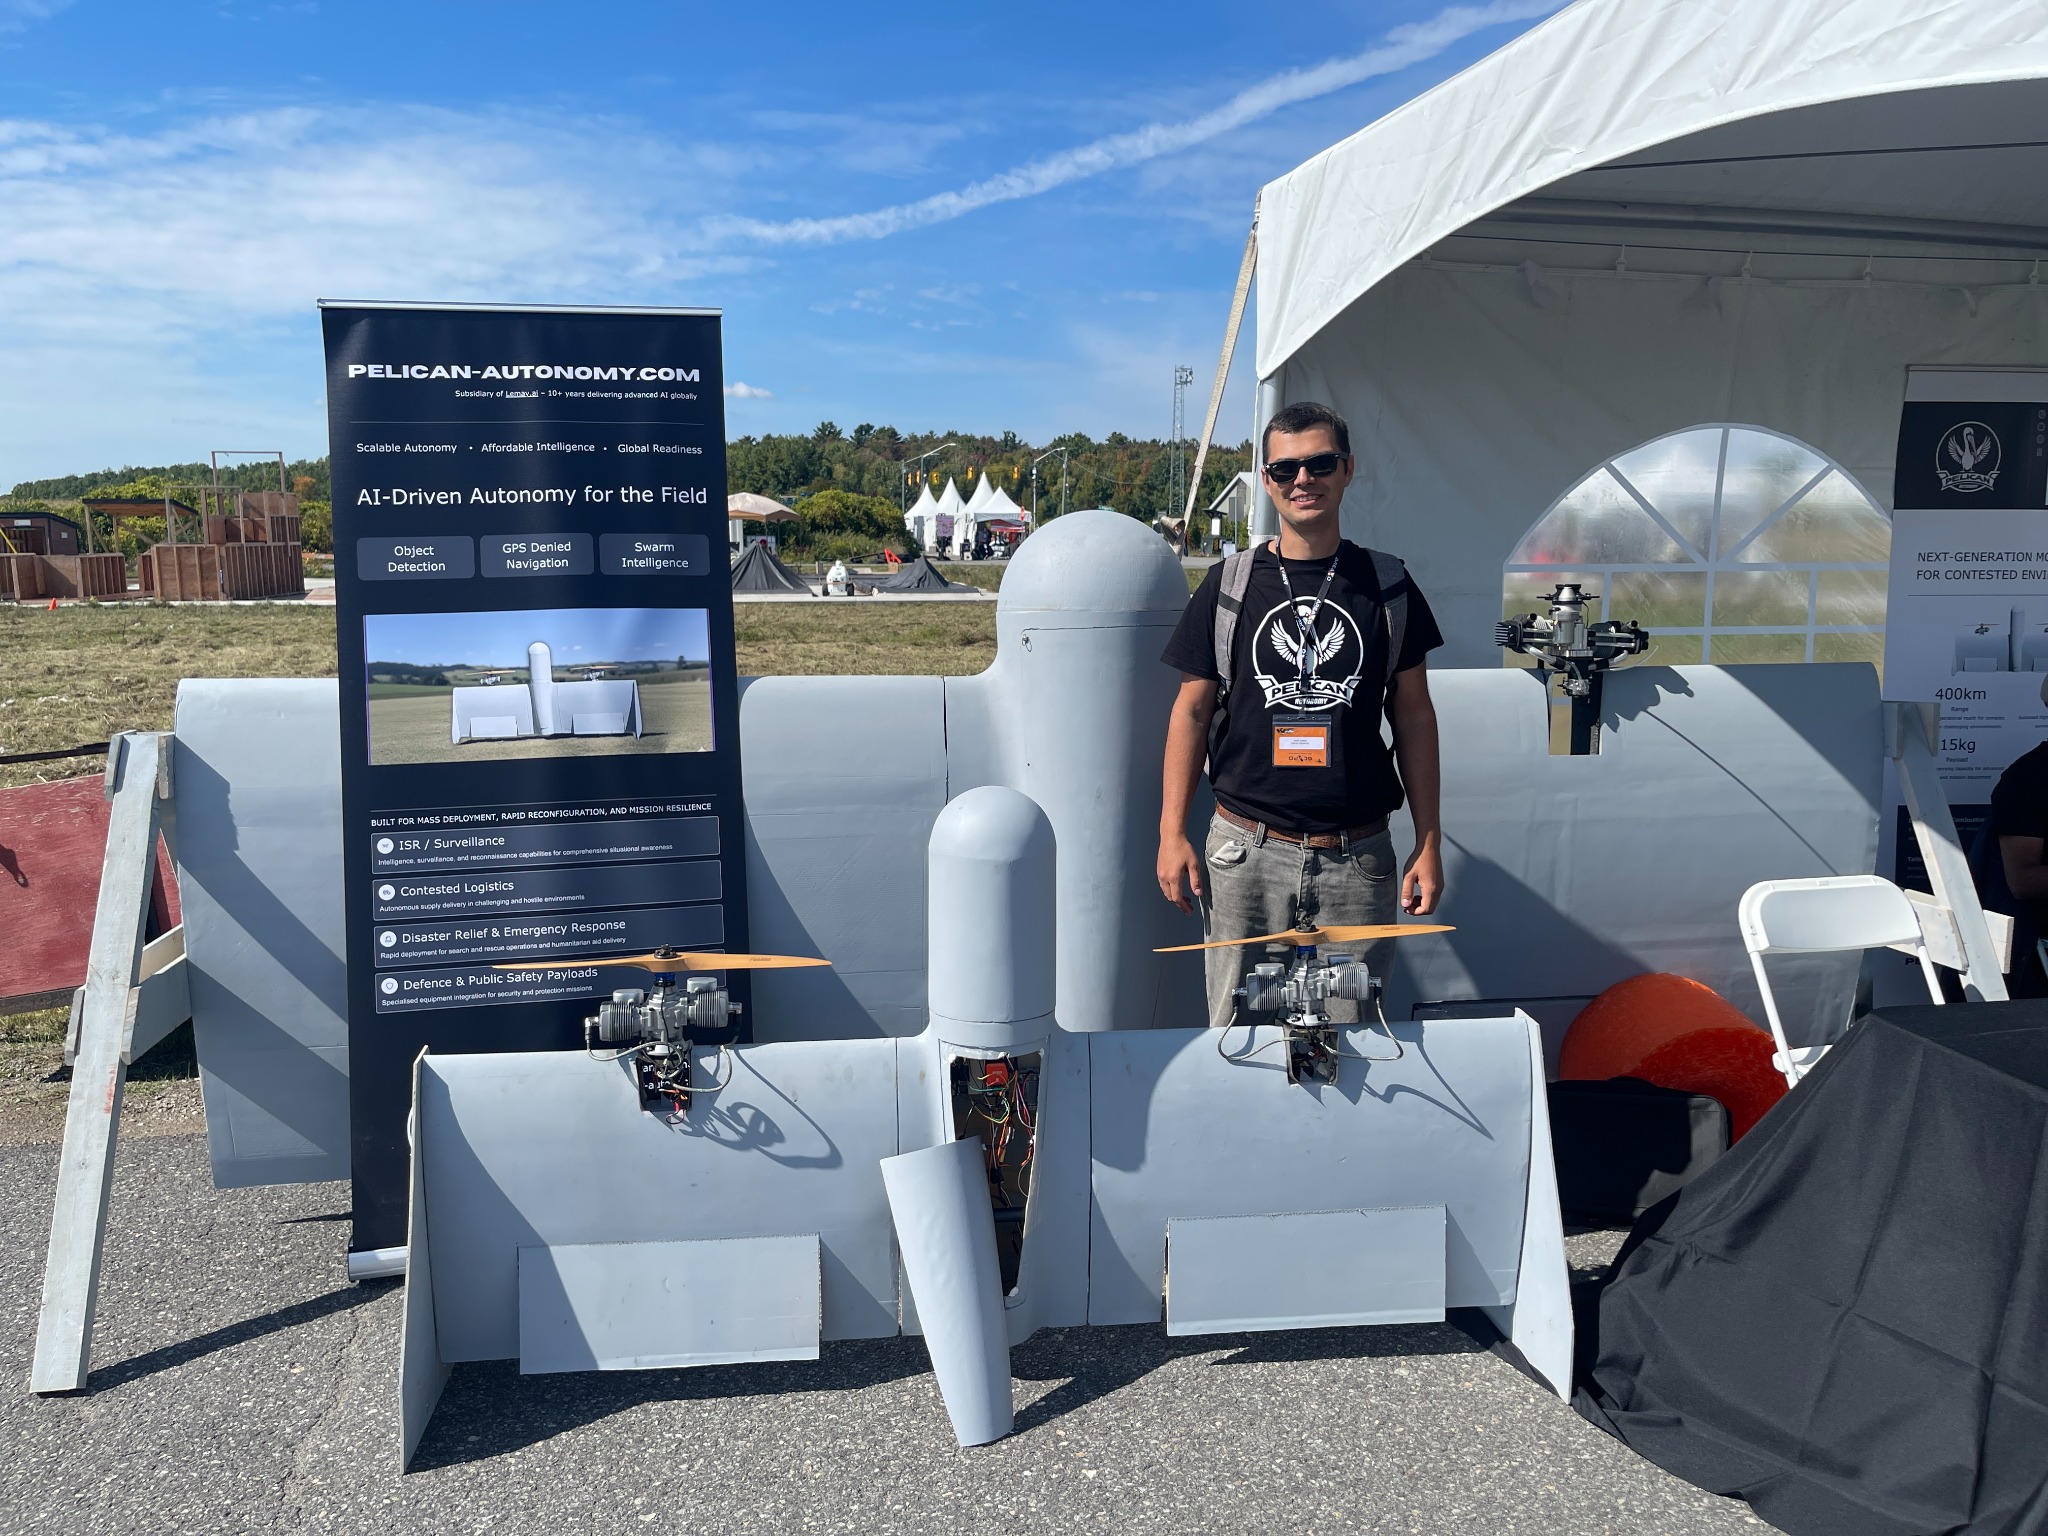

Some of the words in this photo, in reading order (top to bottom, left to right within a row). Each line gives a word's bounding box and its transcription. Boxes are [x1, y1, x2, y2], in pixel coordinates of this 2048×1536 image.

[348, 364, 700, 382] PELICAN-AUTONOMY.COM
[455, 389, 494, 398] Subsidiary
[495, 389, 504, 397] of
[548, 389, 562, 397] 10+
[587, 390, 622, 399] delivering
[624, 391, 658, 399] advanced
[660, 391, 668, 399] AI
[670, 392, 697, 400] globally
[356, 442, 400, 453] Scalable
[404, 443, 457, 454] Autonomy
[481, 442, 533, 452] Affordable
[536, 442, 595, 453] Intelligence
[617, 443, 649, 453] Global
[653, 444, 702, 454] Readiness
[1945, 473, 1990, 485] PELICAN
[357, 487, 462, 506] AI-Driven
[469, 487, 576, 506] Autonomy
[584, 485, 614, 503] for
[620, 485, 654, 503] the
[661, 486, 707, 504] Field
[394, 545, 434, 558] Object
[502, 542, 527, 553] GPS
[531, 541, 571, 552] Denied
[634, 542, 674, 552] Swarm
[621, 557, 688, 569] Intelligence
[1917, 551, 2032, 562] NEXT-GENERATION
[388, 561, 446, 572] Detection
[506, 557, 569, 570] Navigation
[1916, 569, 1940, 580] FOR
[1944, 569, 2018, 580] CONTESTED
[2021, 569, 2048, 580] ENVI
[1935, 687, 1986, 700] 400km
[1940, 738, 1976, 754] 15kg
[371, 818, 395, 827] BUILT
[398, 817, 415, 825] FOR
[417, 815, 440, 824] MASS
[442, 813, 498, 823] DEPLOYMENT,
[501, 811, 526, 820] RAPID
[528, 808, 607, 819] RECONFIGURATION,
[609, 807, 627, 815] AND
[629, 805, 664, 814] MISSION
[666, 802, 711, 812] RESILIENCE
[399, 839, 421, 850] ISR
[424, 838, 430, 850] /
[434, 836, 505, 849] Surveillance
[470, 853, 518, 861] reconnaissance
[518, 849, 552, 859] capabilities
[562, 847, 608, 856] comprehensive
[609, 845, 640, 853] situational
[400, 882, 460, 897] Contested
[464, 881, 514, 894] Logistics
[420, 902, 441, 910] supply
[442, 900, 466, 909] delivery
[474, 898, 509, 907] challenging
[544, 894, 585, 903] environments
[402, 931, 451, 944] Disaster
[455, 927, 488, 940] Relief
[491, 927, 500, 937] &
[504, 924, 567, 937] Emergency
[571, 921, 626, 933] Response
[380, 951, 399, 959] Rapid
[400, 949, 437, 958] deployment
[470, 945, 482, 953] and
[505, 942, 537, 951] operations
[551, 939, 590, 948] humanitarian
[602, 937, 626, 945] delivery
[403, 978, 452, 990] Defence
[456, 976, 465, 986] &
[468, 973, 503, 985] Public
[506, 971, 543, 983] Safety
[547, 967, 598, 981] Payloads
[381, 997, 419, 1006] Specialised
[419, 995, 453, 1003] equipment
[453, 992, 486, 1001] integration
[497, 989, 521, 998] security
[534, 987, 565, 995] protection
